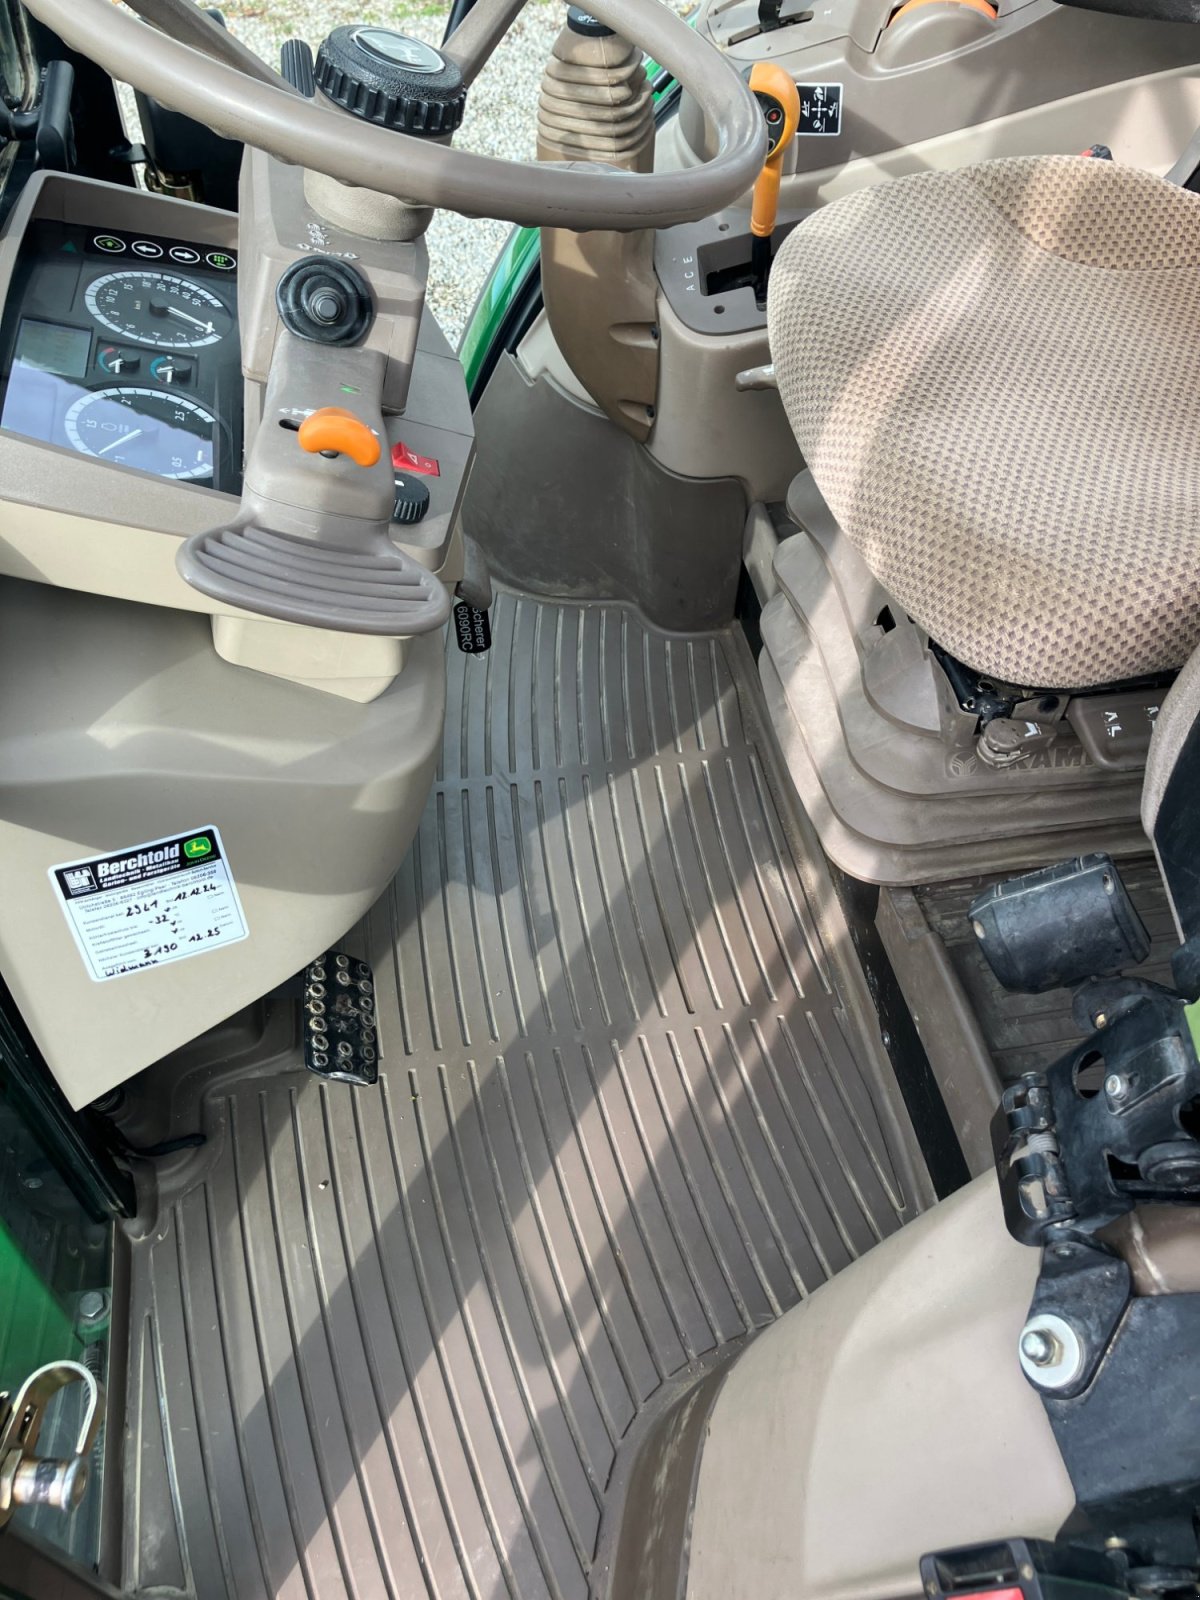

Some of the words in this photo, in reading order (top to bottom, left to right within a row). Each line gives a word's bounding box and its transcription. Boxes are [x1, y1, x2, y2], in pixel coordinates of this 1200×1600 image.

[683, 255, 693, 264] E
[684, 271, 694, 279] C
[123, 281, 134, 291] 15
[156, 281, 166, 291] 20
[108, 289, 118, 297] 12
[105, 296, 115, 304] 10
[457, 606, 473, 651] 6090RC
[97, 844, 180, 878] Berchtold
